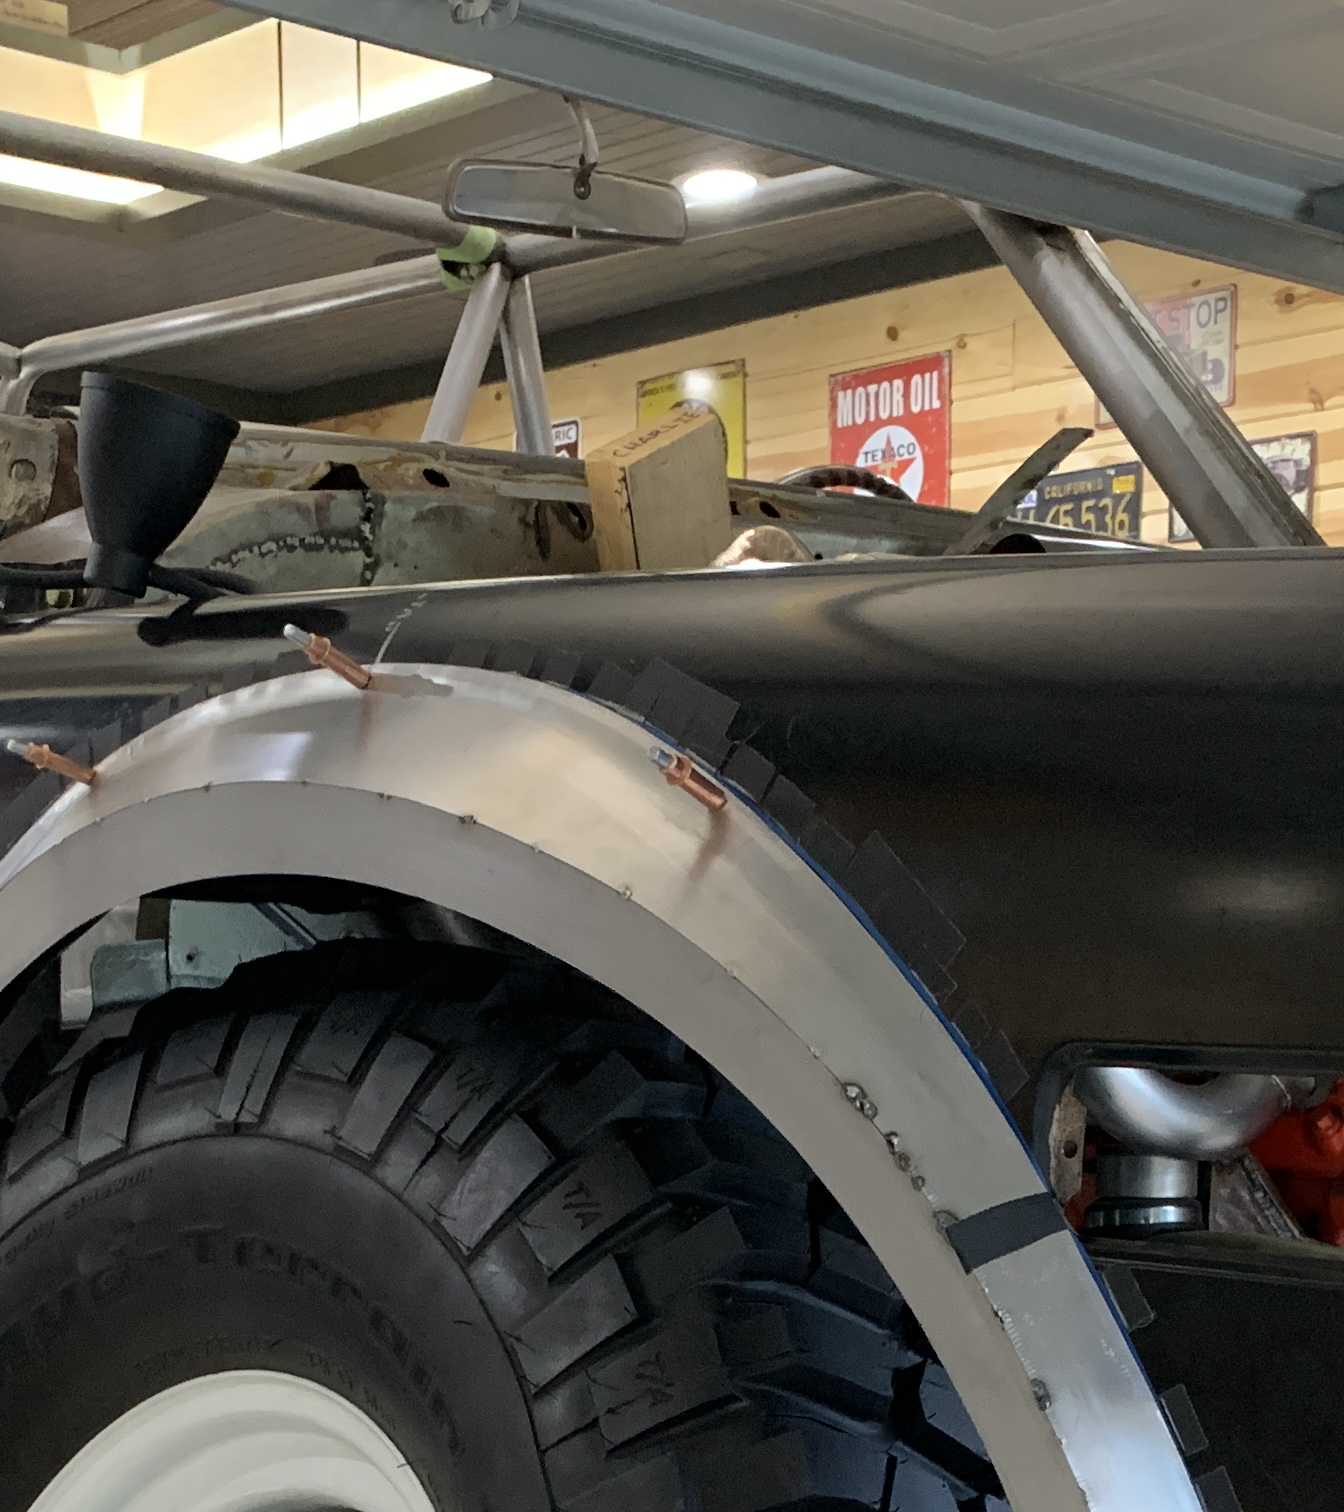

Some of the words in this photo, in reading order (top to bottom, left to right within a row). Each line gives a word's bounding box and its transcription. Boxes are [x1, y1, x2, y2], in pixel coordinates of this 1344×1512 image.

[1168, 297, 1228, 331] STOP
[836, 378, 904, 428] MOTOR
[910, 370, 941, 414] OIL
[862, 442, 916, 464] TEXACO
[1044, 478, 1104, 500] CALIFORNIA
